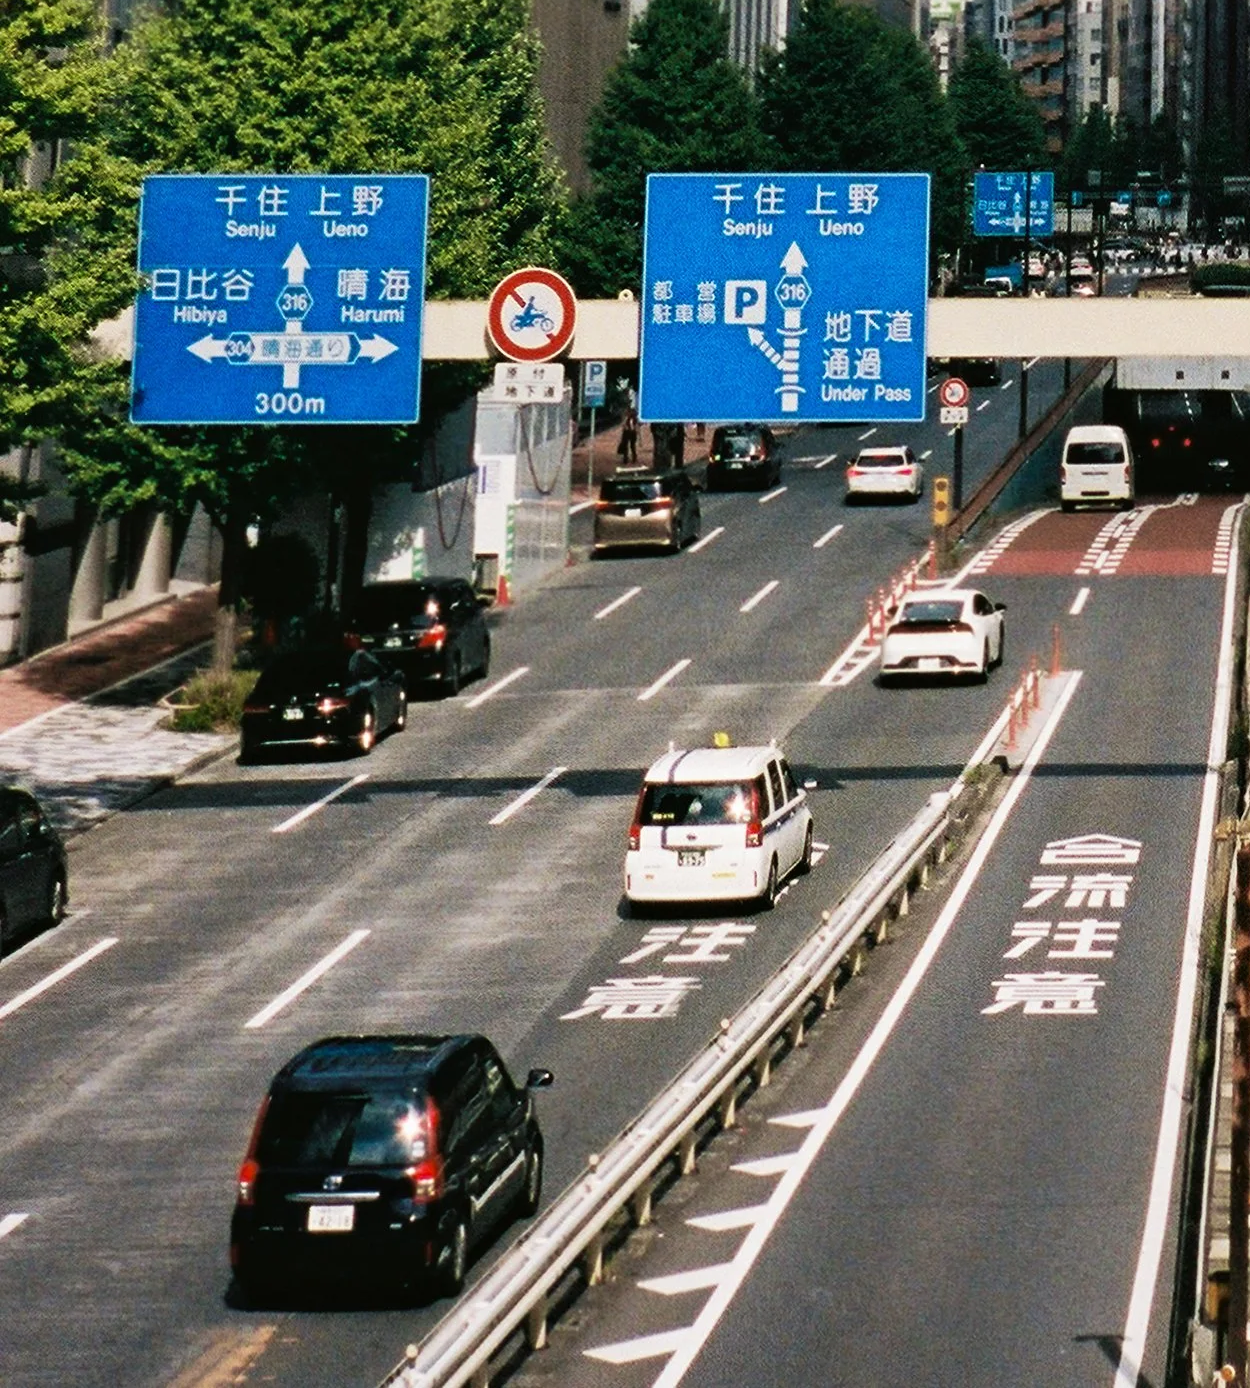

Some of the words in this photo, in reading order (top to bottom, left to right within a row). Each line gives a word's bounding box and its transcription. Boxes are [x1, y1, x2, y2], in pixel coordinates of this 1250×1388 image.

[215, 185, 290, 216] 千住
[309, 185, 384, 216] 上野
[713, 183, 786, 215] 千住
[806, 183, 879, 215] 上野
[226, 221, 276, 240] Senju
[324, 221, 368, 237] Ueno
[723, 219, 773, 238] Senju
[819, 219, 864, 236] Ueno
[151, 269, 254, 300] 日比谷
[337, 269, 411, 300] 晴海
[653, 281, 717, 302] 都営
[781, 285, 805, 300] 316
[283, 293, 307, 310] 316
[735, 286, 759, 318] P
[174, 306, 228, 326] Hibiya
[341, 306, 405, 323] Harumi
[824, 310, 913, 342] 地下道
[590, 364, 603, 381] P
[822, 348, 881, 380] 通過
[505, 384, 555, 398] 地下道
[821, 385, 867, 402] Under
[874, 385, 912, 402] Pass
[255, 393, 326, 414] 300m
[980, 833, 1142, 1015] 合流注意
[559, 922, 757, 1020] 注意
